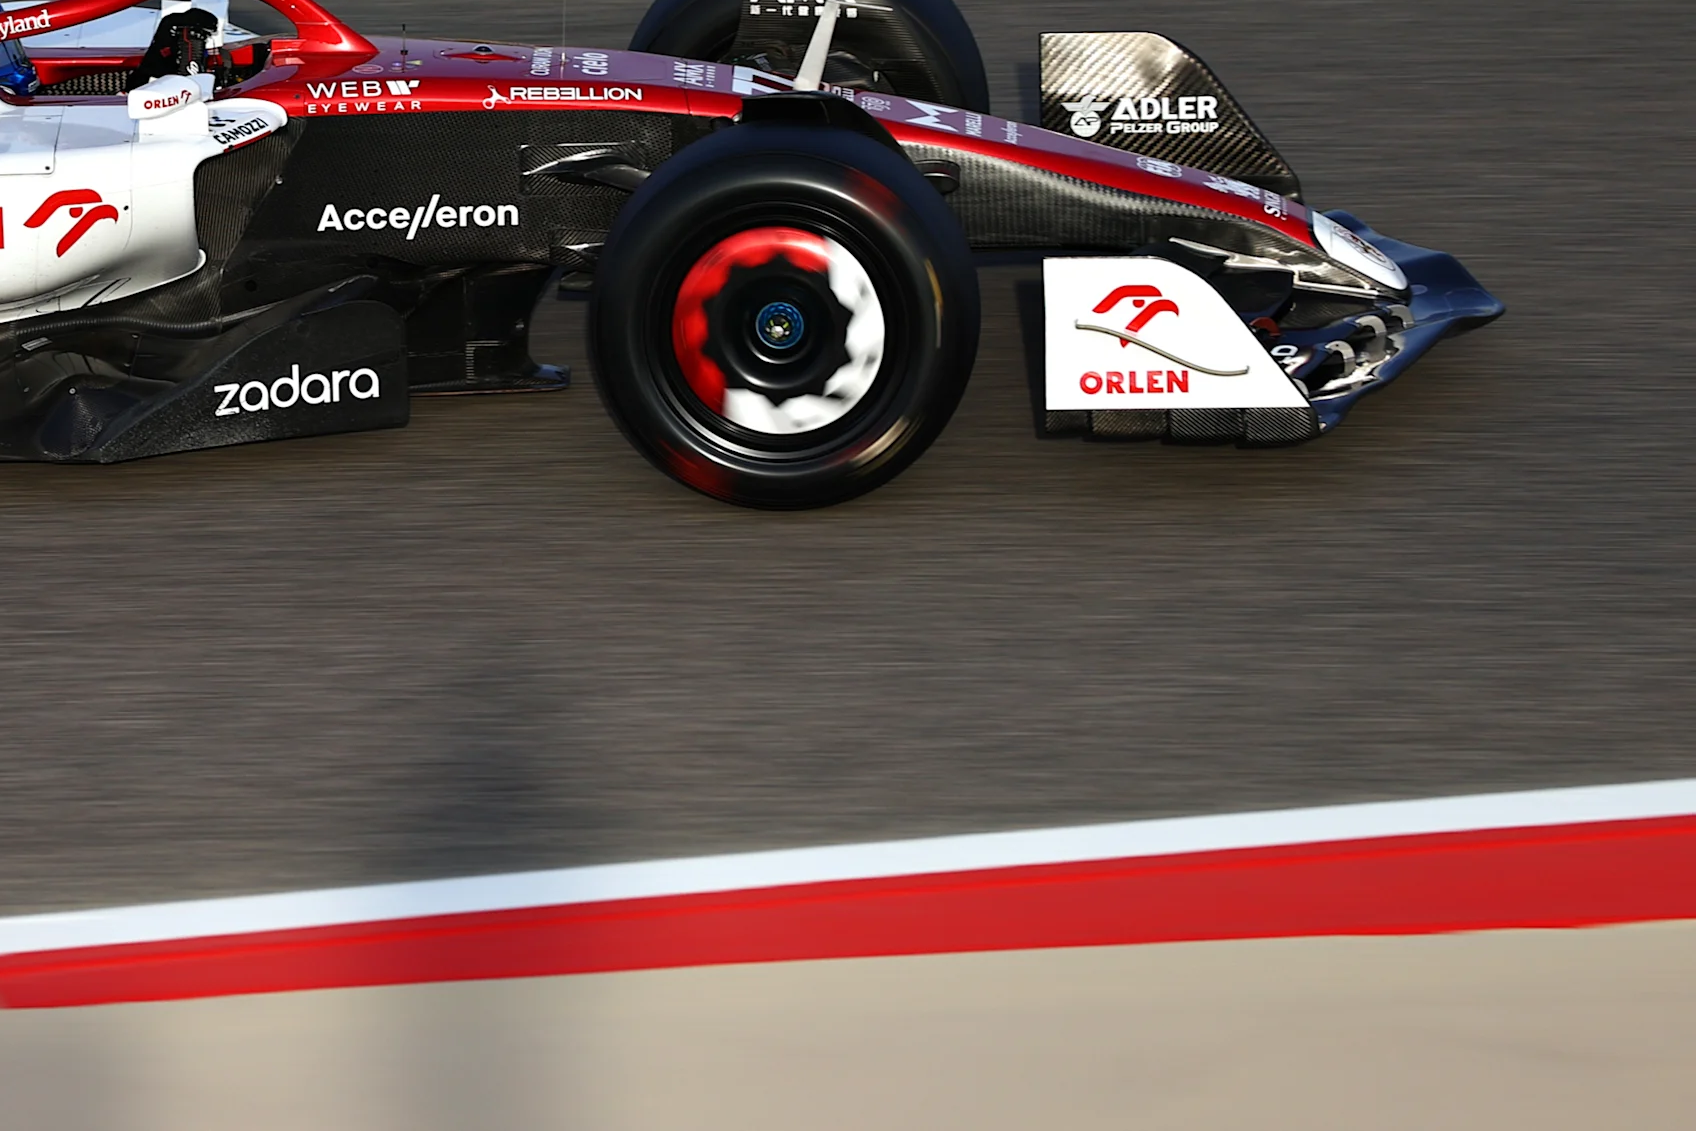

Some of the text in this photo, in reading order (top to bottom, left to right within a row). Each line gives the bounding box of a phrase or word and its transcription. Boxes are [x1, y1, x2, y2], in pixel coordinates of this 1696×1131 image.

[573, 52, 609, 76] cielo
[307, 80, 382, 99] WEB
[510, 86, 643, 102] REBELLION
[144, 96, 179, 110] ORLEN
[307, 101, 422, 114] EYEWEAR
[1111, 95, 1218, 120] ADLER
[213, 117, 269, 145] CAMOZZI
[213, 364, 380, 417] zadara
[1079, 371, 1189, 395] ORLEN
